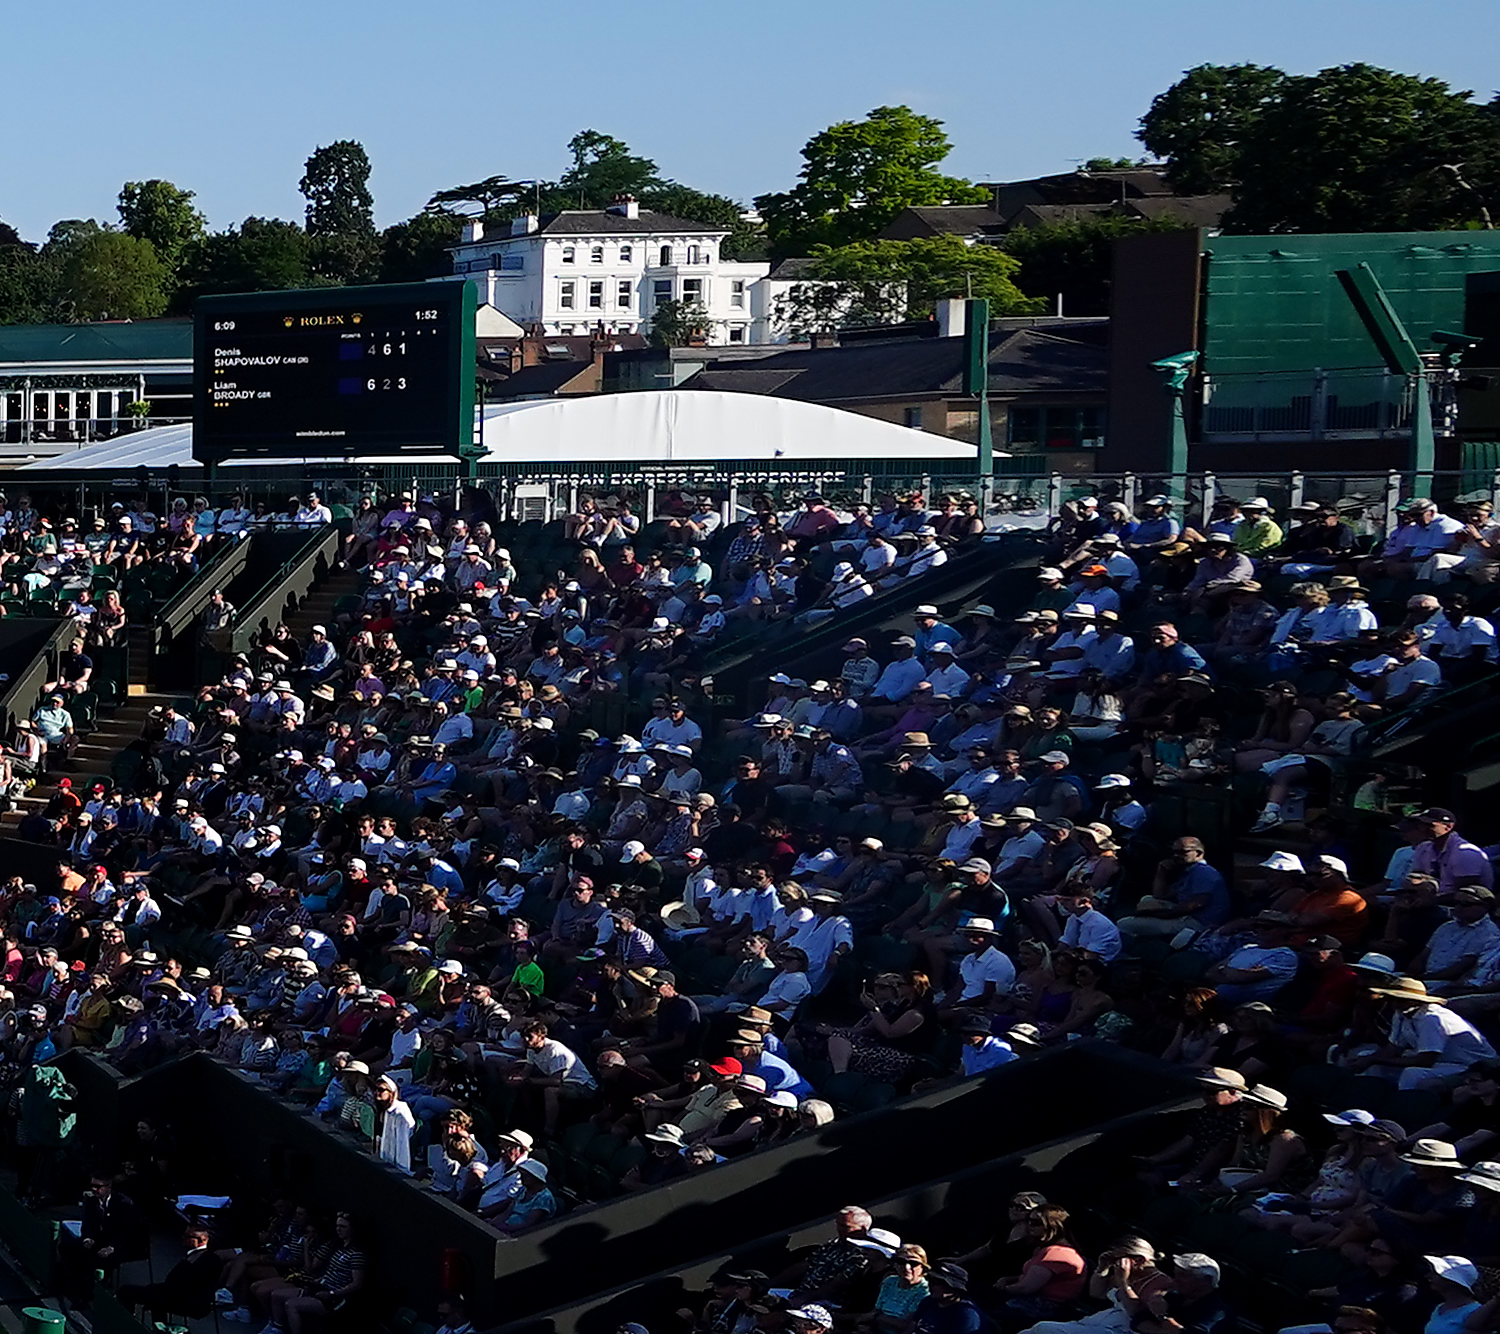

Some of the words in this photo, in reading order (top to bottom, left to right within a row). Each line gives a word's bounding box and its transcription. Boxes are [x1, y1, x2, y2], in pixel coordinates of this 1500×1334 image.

[415, 310, 438, 320] 1:52
[213, 320, 236, 331] 6:09
[299, 315, 345, 327] ROLEX
[214, 347, 242, 357] Denis
[367, 344, 376, 355] 4
[382, 343, 392, 355] 6
[398, 342, 406, 355] 1
[214, 356, 281, 367] SHAPOVALOV
[213, 381, 237, 390] Liam
[367, 378, 376, 390] 6
[382, 378, 391, 390] 2
[397, 377, 407, 389] 3
[213, 390, 255, 400] BROADY
